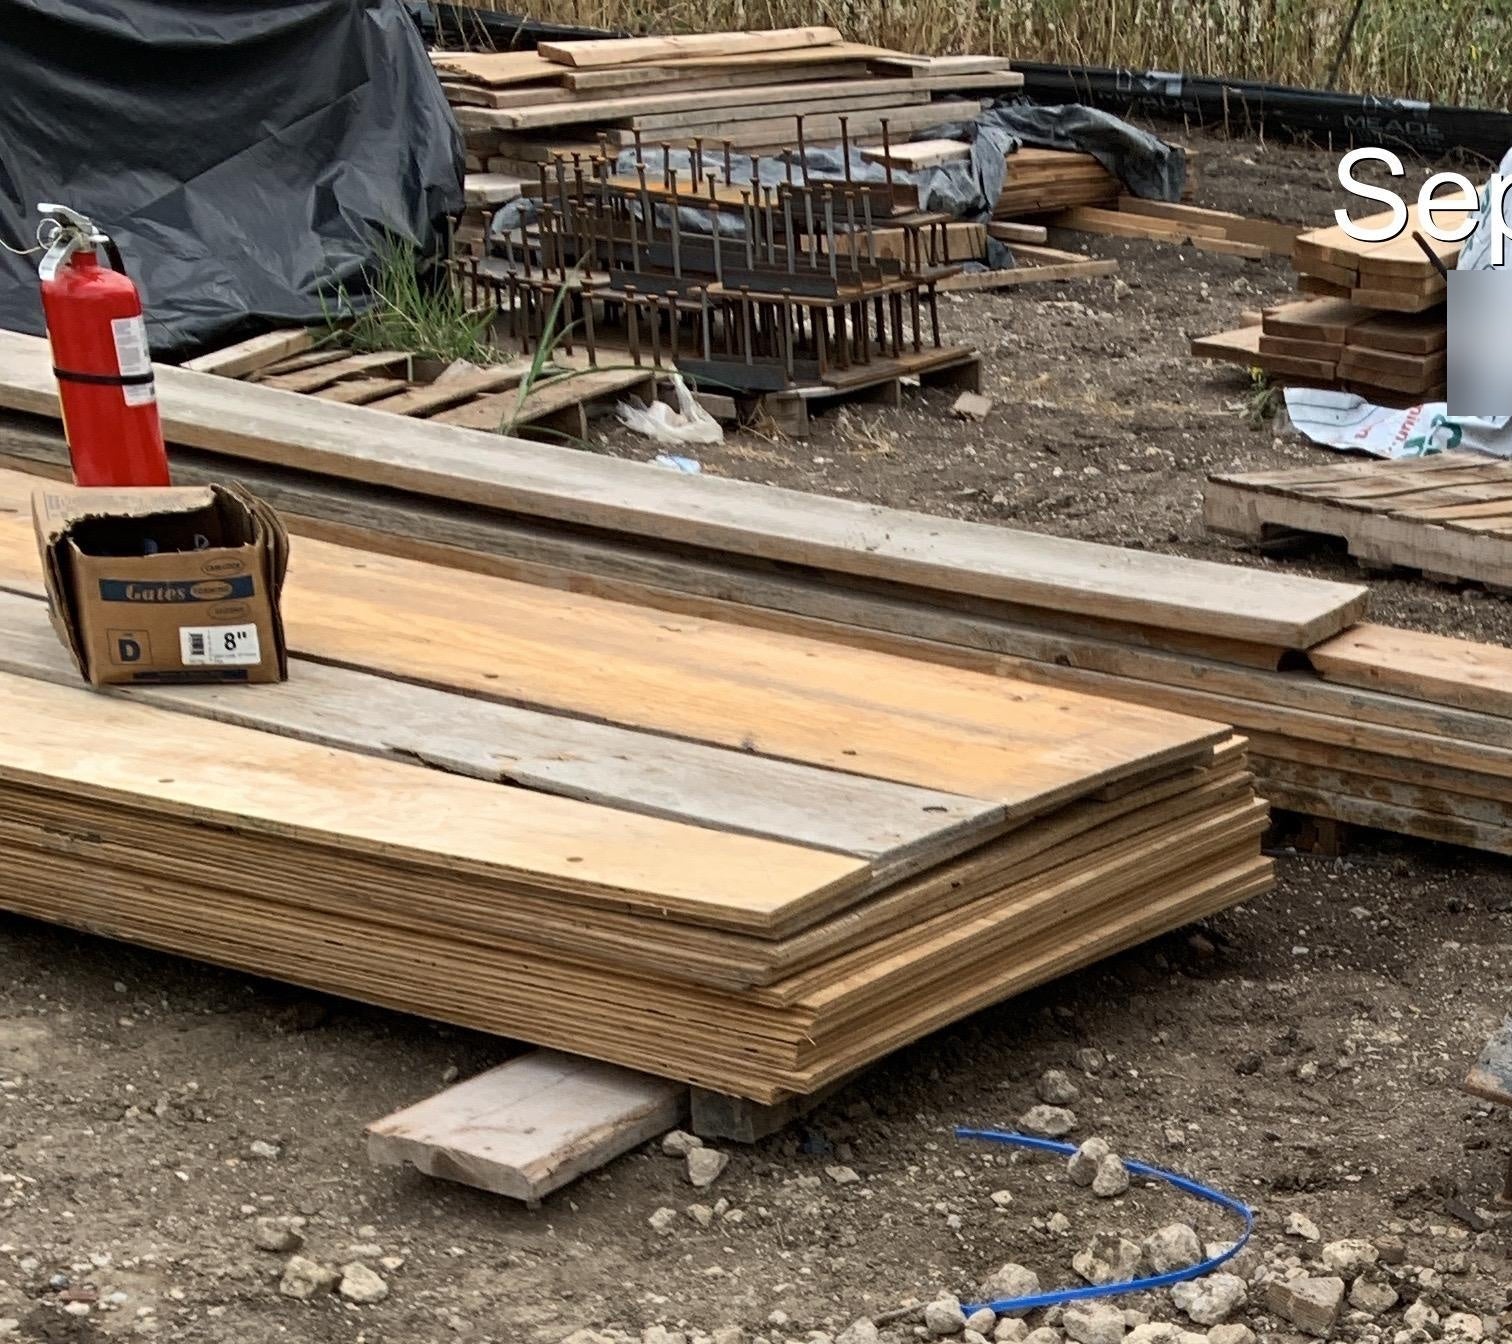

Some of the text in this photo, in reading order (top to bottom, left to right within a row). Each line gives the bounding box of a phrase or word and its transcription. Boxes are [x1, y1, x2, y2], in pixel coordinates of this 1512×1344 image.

[125, 583, 187, 601] Gates
[117, 638, 141, 662] D
[223, 630, 247, 652] 8"
